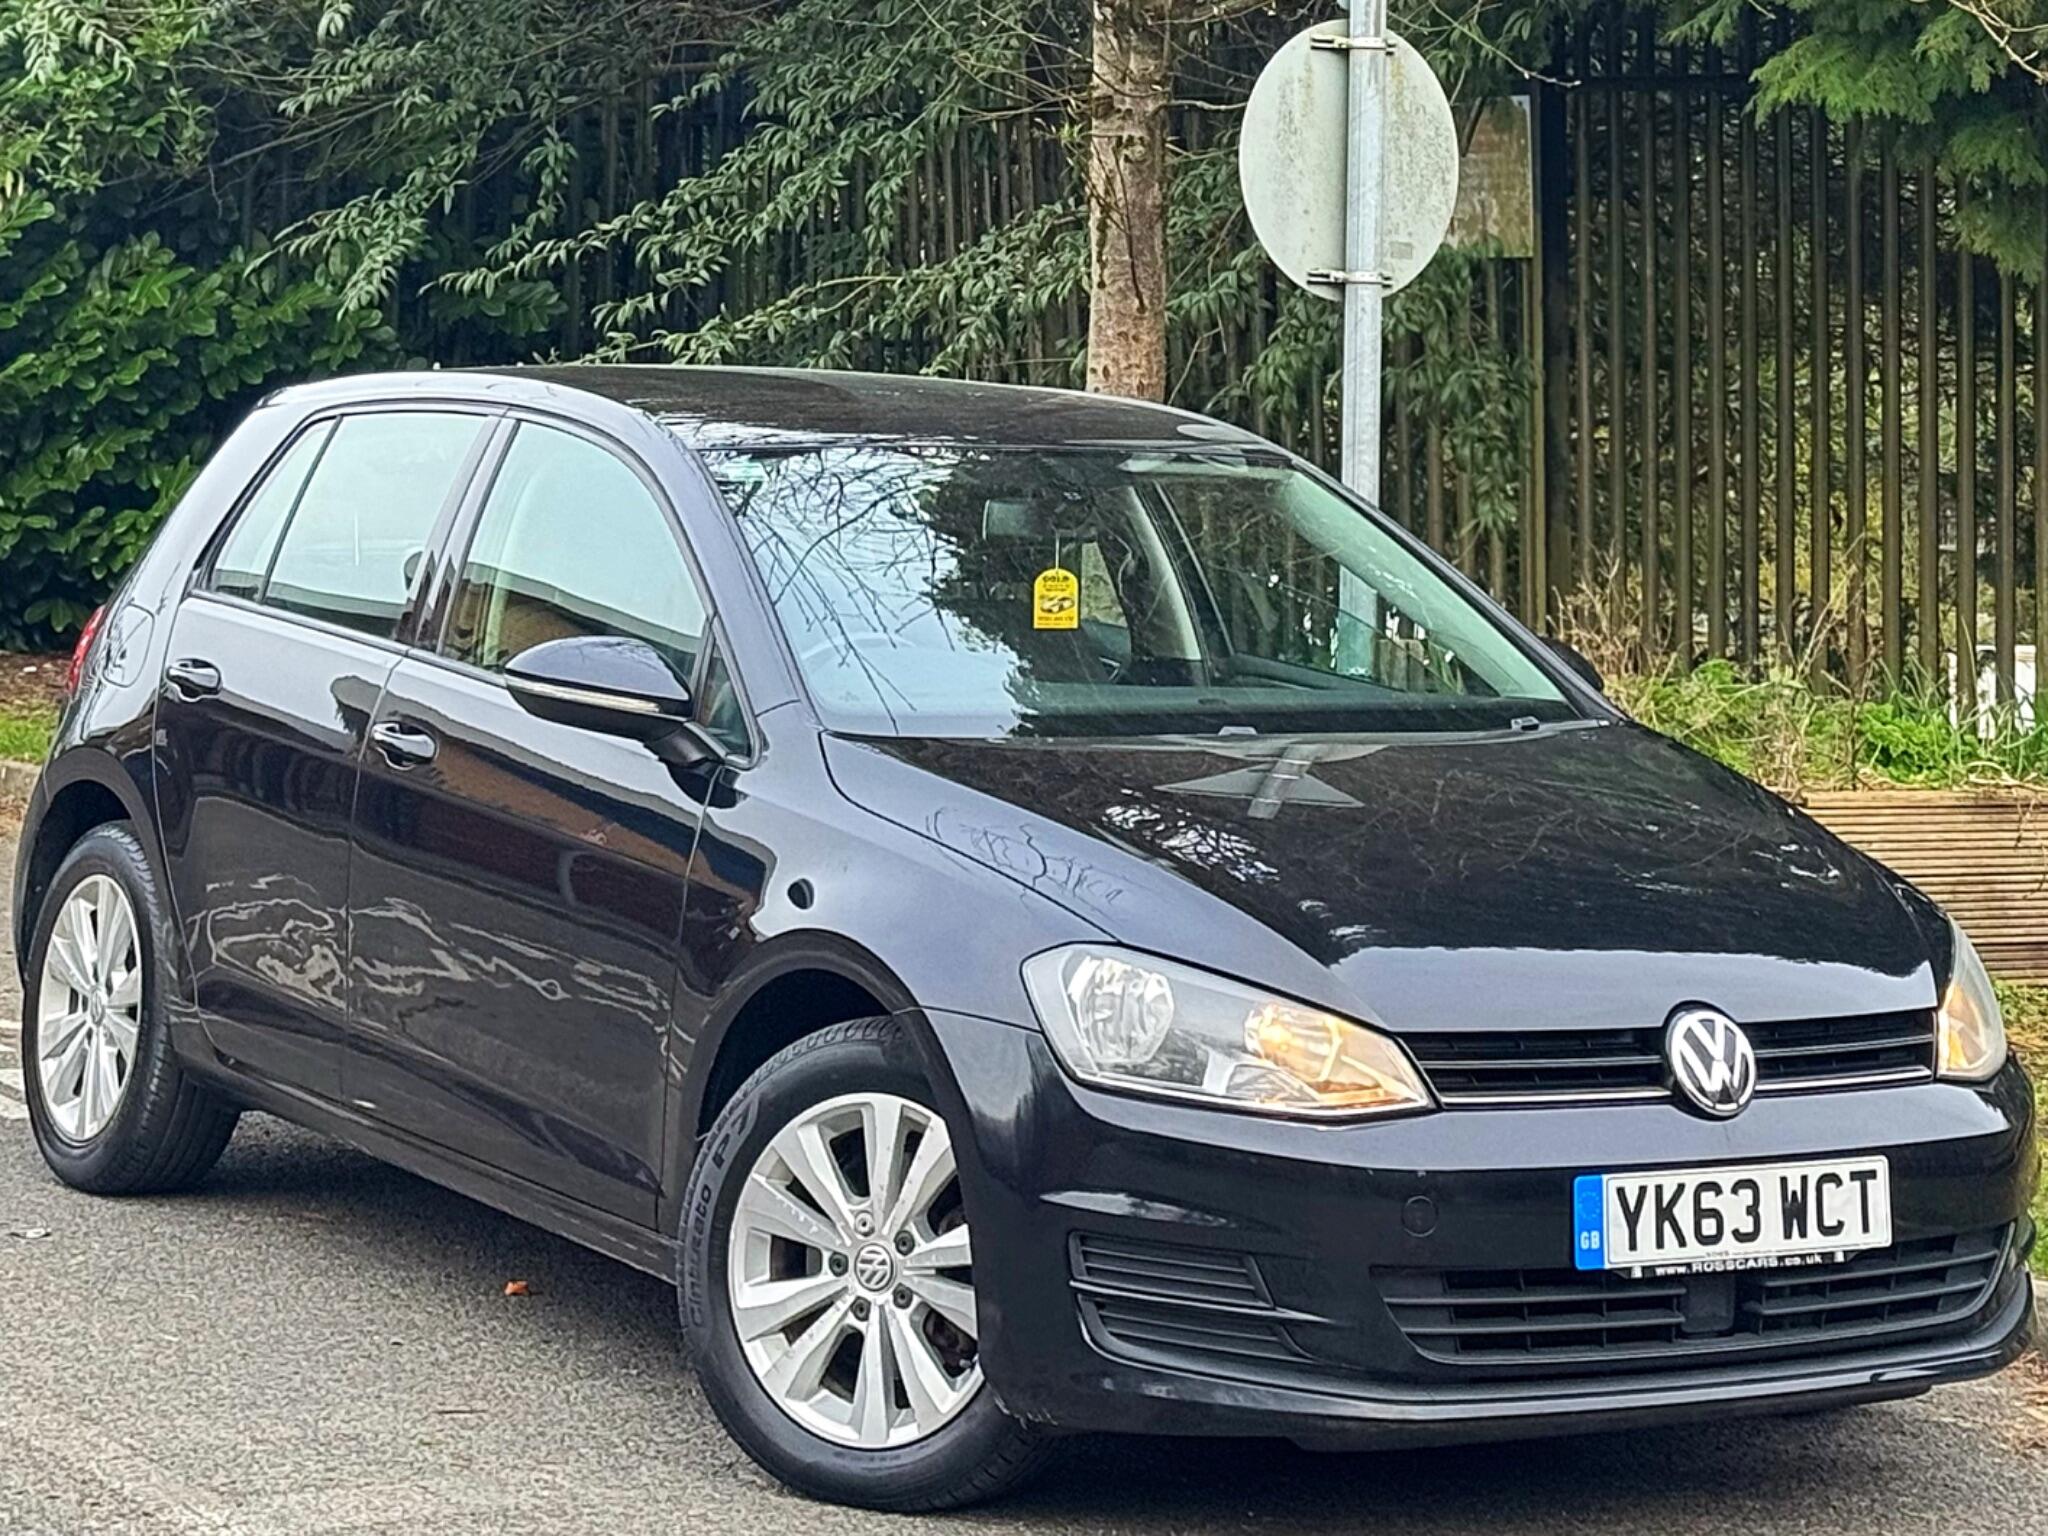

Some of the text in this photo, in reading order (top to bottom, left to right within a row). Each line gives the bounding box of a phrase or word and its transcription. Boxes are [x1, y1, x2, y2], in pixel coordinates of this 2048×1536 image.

[1616, 1168, 1878, 1251] YK63 WCT
[1580, 1230, 1600, 1250] GB
